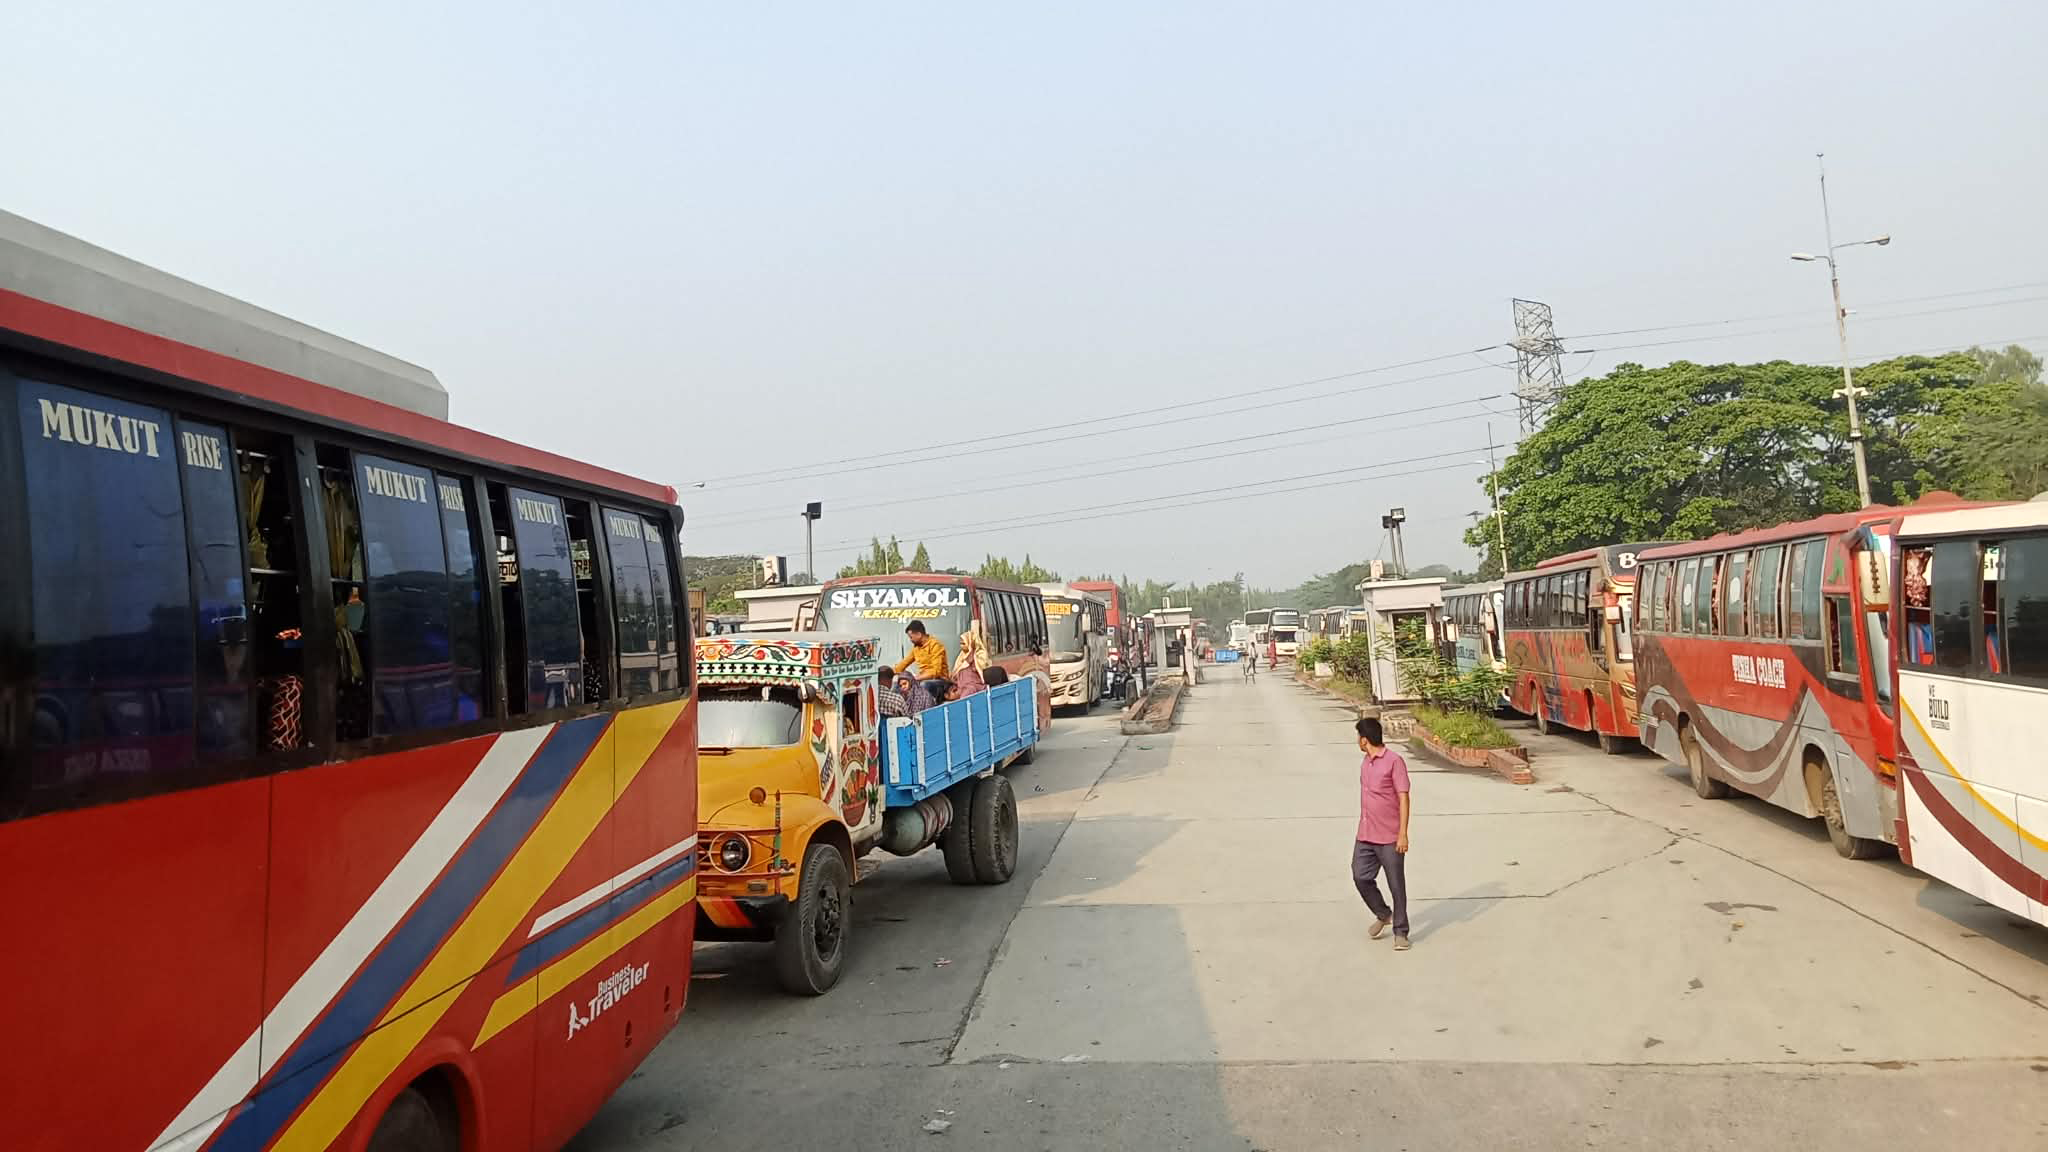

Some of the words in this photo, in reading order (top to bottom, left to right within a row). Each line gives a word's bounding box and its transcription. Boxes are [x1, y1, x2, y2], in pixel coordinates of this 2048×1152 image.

[38, 398, 160, 458] MUKUT
[181, 431, 223, 471] RISE
[364, 465, 427, 504] MUKUT
[515, 497, 558, 526] MUKUT
[609, 515, 641, 540] MUKUT
[830, 587, 967, 609] SHYAMOLI
[1928, 698, 1949, 720] BUILD
[588, 962, 650, 1022] Traveler
